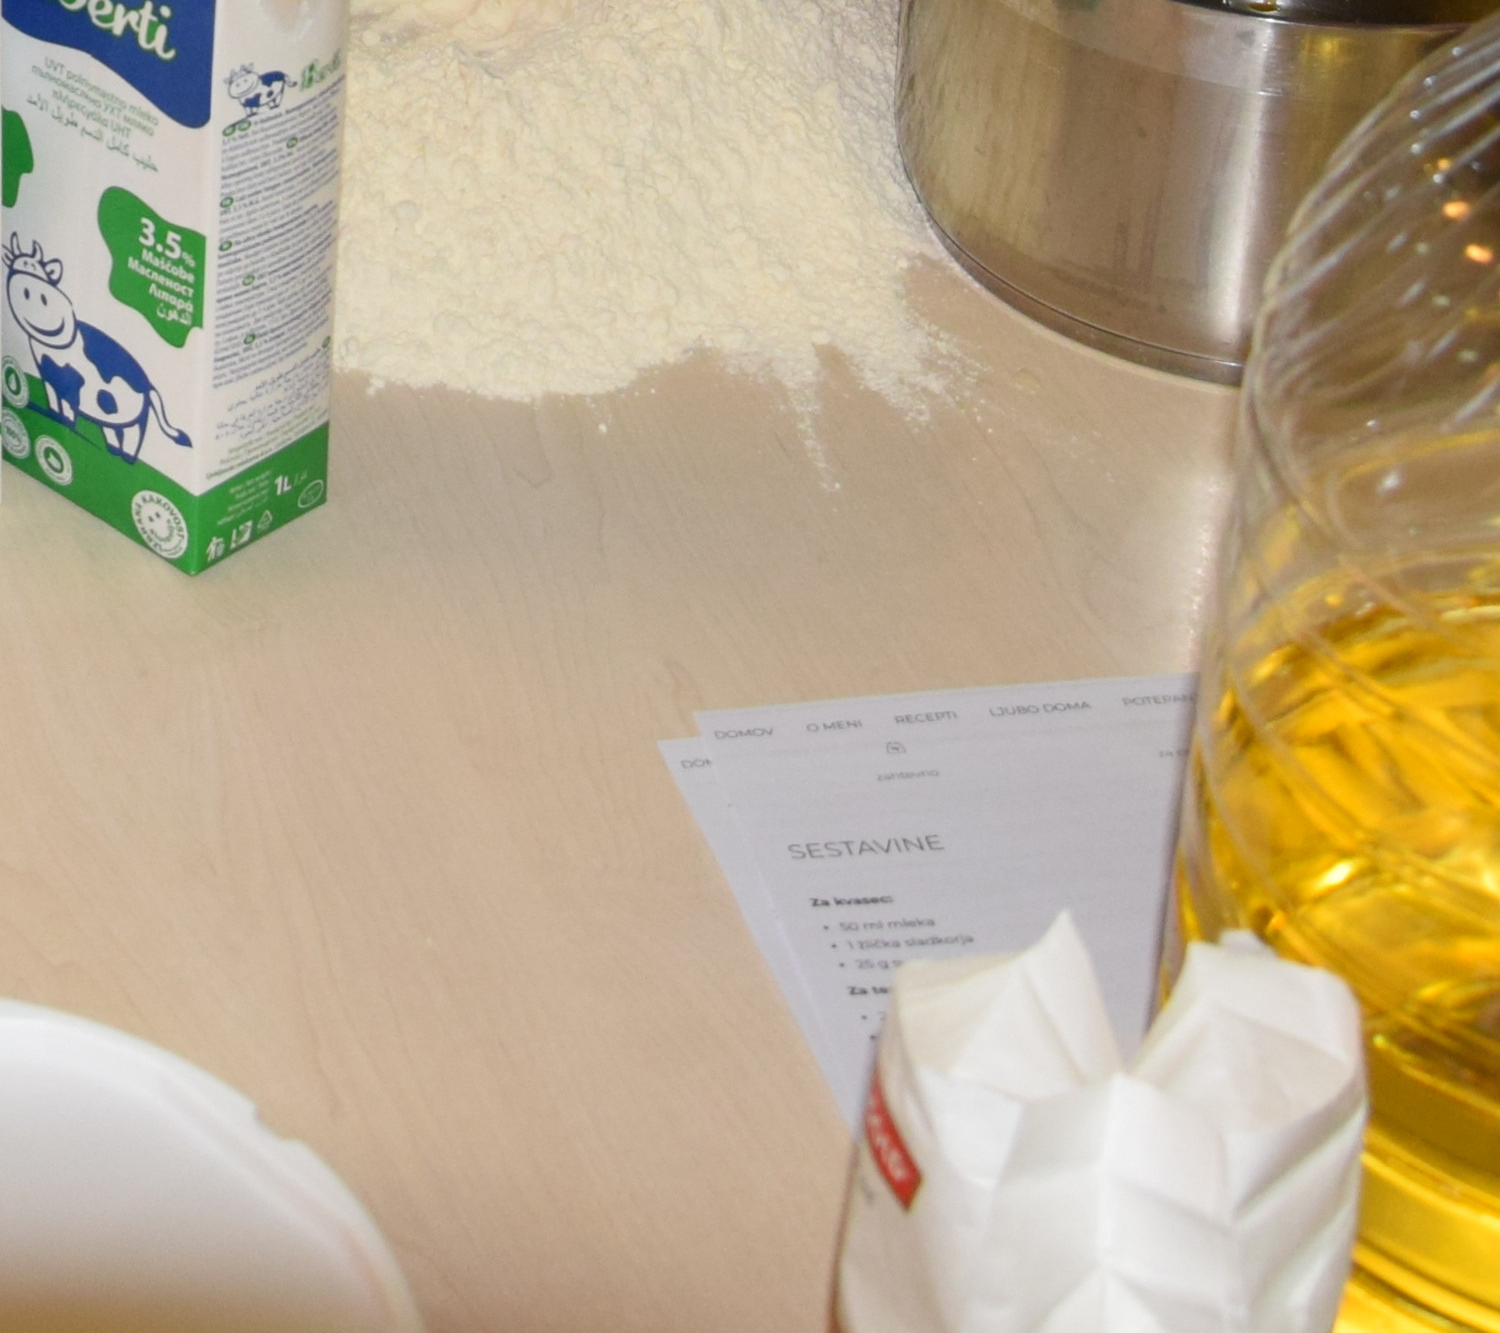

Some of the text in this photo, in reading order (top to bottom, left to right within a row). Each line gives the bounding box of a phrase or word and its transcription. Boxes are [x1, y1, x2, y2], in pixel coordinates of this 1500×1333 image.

[138, 216, 196, 268] 3.5%
[713, 727, 774, 740] DOMOV
[806, 722, 820, 733] O
[822, 719, 863, 731] MENI
[894, 710, 958, 724] RECEPTI
[988, 704, 1041, 718] LJUBO
[1042, 700, 1092, 714] DOMA
[787, 834, 945, 860] SESTAVINE
[809, 897, 831, 908] Za
[848, 986, 869, 996] Za
